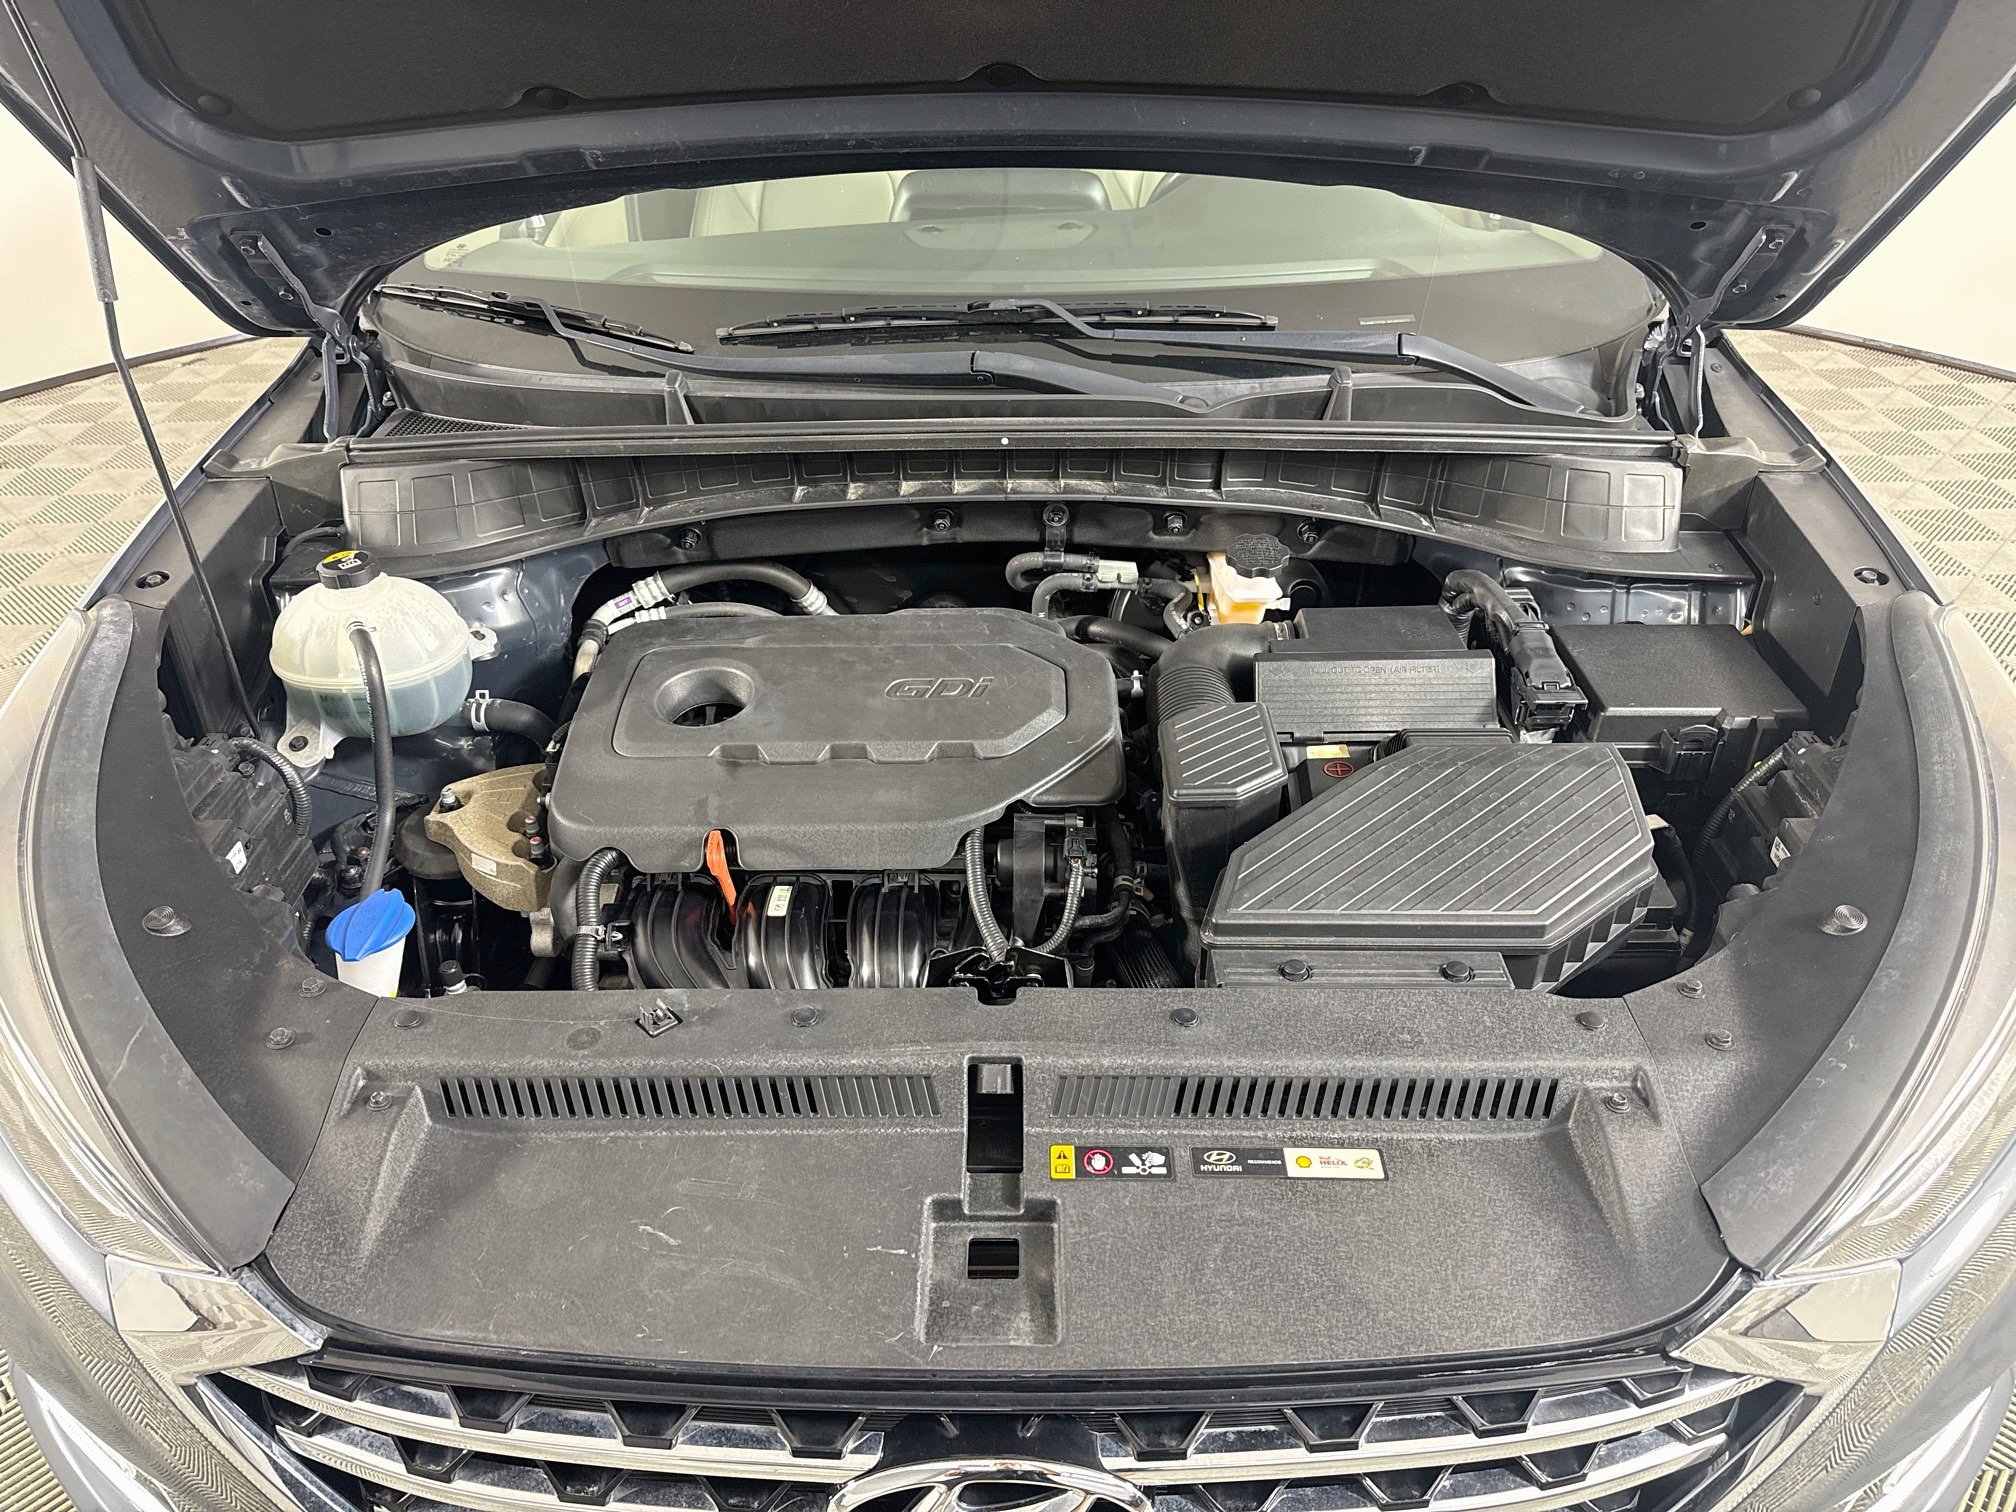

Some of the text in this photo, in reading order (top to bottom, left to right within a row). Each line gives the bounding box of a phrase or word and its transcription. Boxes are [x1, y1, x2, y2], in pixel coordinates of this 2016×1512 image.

[1332, 666, 1349, 674] OUT
[1350, 666, 1362, 674] TO
[1363, 665, 1387, 674] OPEN
[1390, 665, 1408, 674] (AIR
[1410, 665, 1440, 674] FILTER)
[884, 677, 995, 699] GDi
[1200, 1164, 1243, 1172] HYUNDAI
